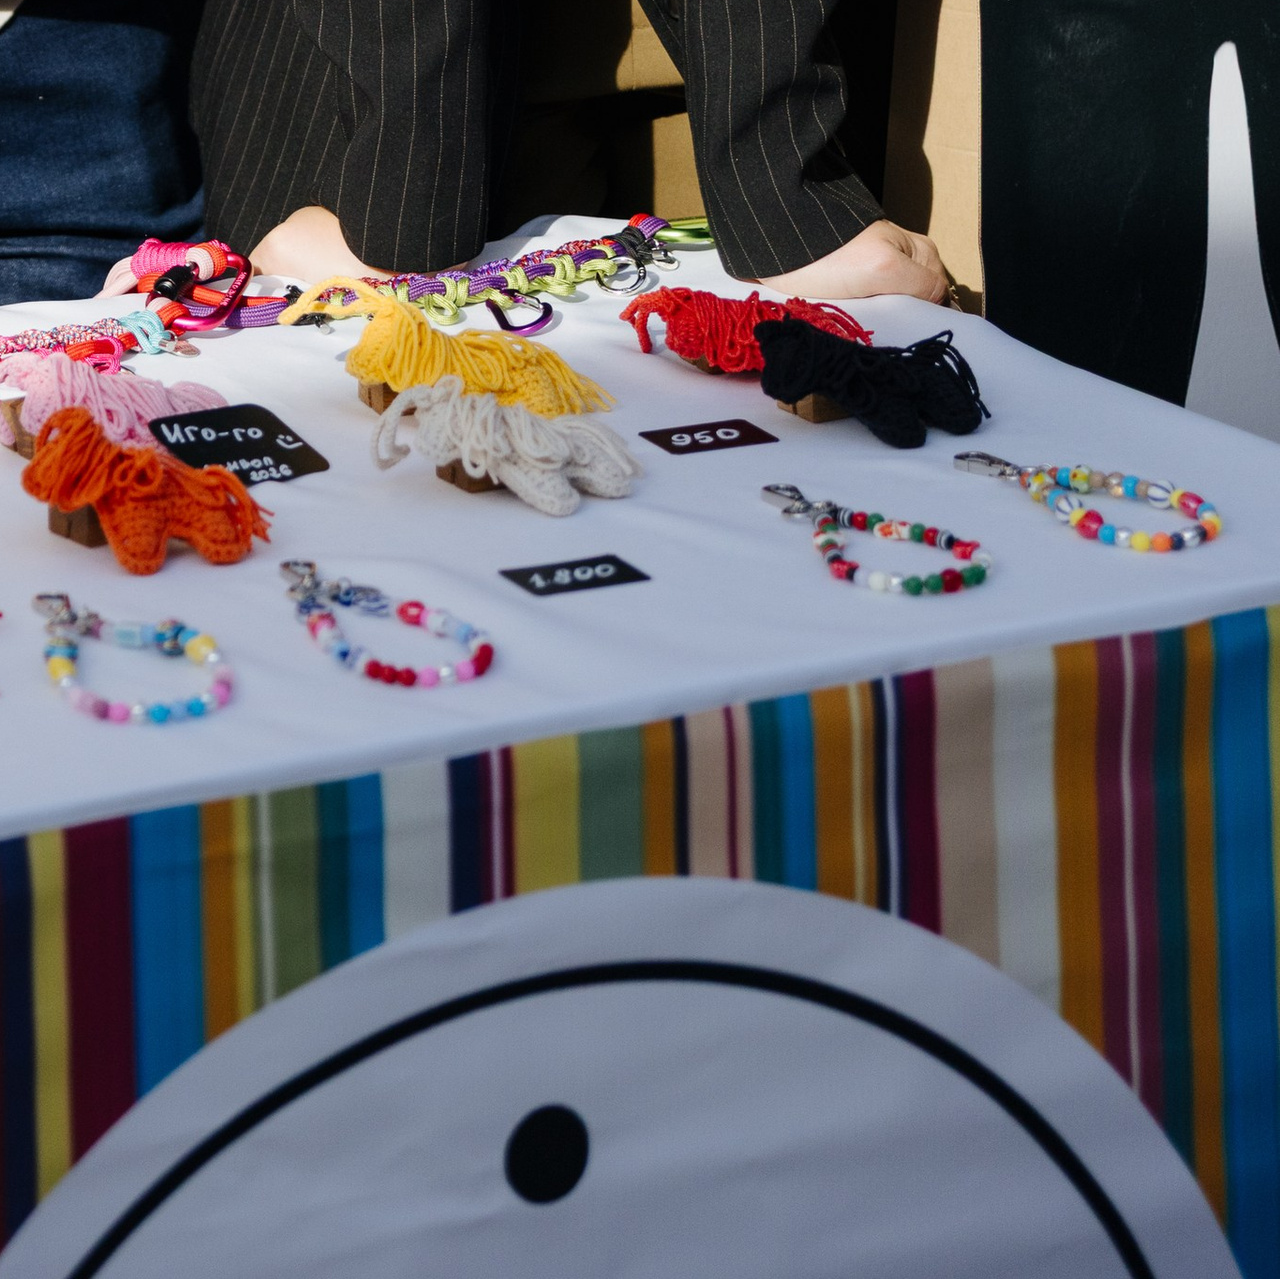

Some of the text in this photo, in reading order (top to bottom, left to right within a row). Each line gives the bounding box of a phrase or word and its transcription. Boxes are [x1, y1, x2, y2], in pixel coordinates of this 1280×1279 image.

[160, 423, 264, 444] Иго-го
[671, 428, 740, 446] 950
[204, 456, 274, 472] мвол
[250, 464, 293, 481] 2026
